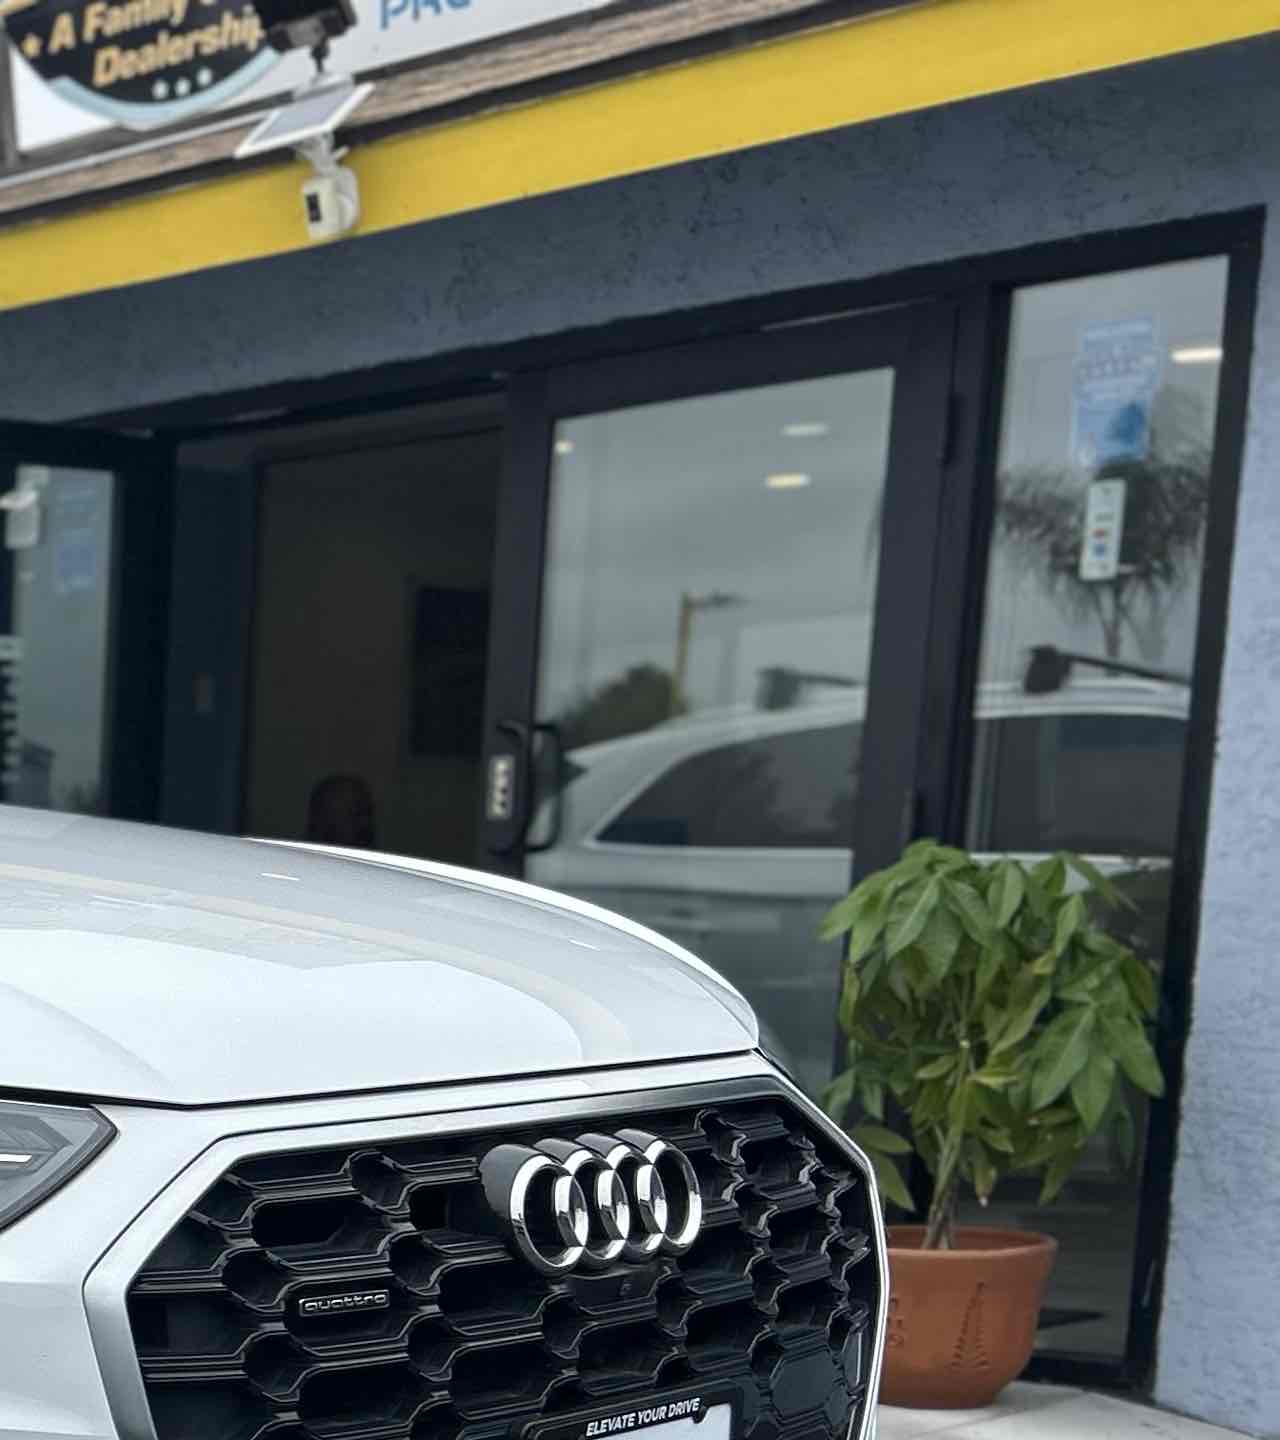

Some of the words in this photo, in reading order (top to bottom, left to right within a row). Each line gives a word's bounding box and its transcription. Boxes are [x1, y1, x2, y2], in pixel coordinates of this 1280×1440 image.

[47, 12, 77, 54] A
[83, 0, 189, 42] Family
[92, 5, 266, 87] Dealership
[304, 1293, 387, 1312] quattro
[586, 1413, 636, 1436] ELEVATE
[637, 1406, 669, 1425] YOUR
[668, 1398, 700, 1417] DRIVE
